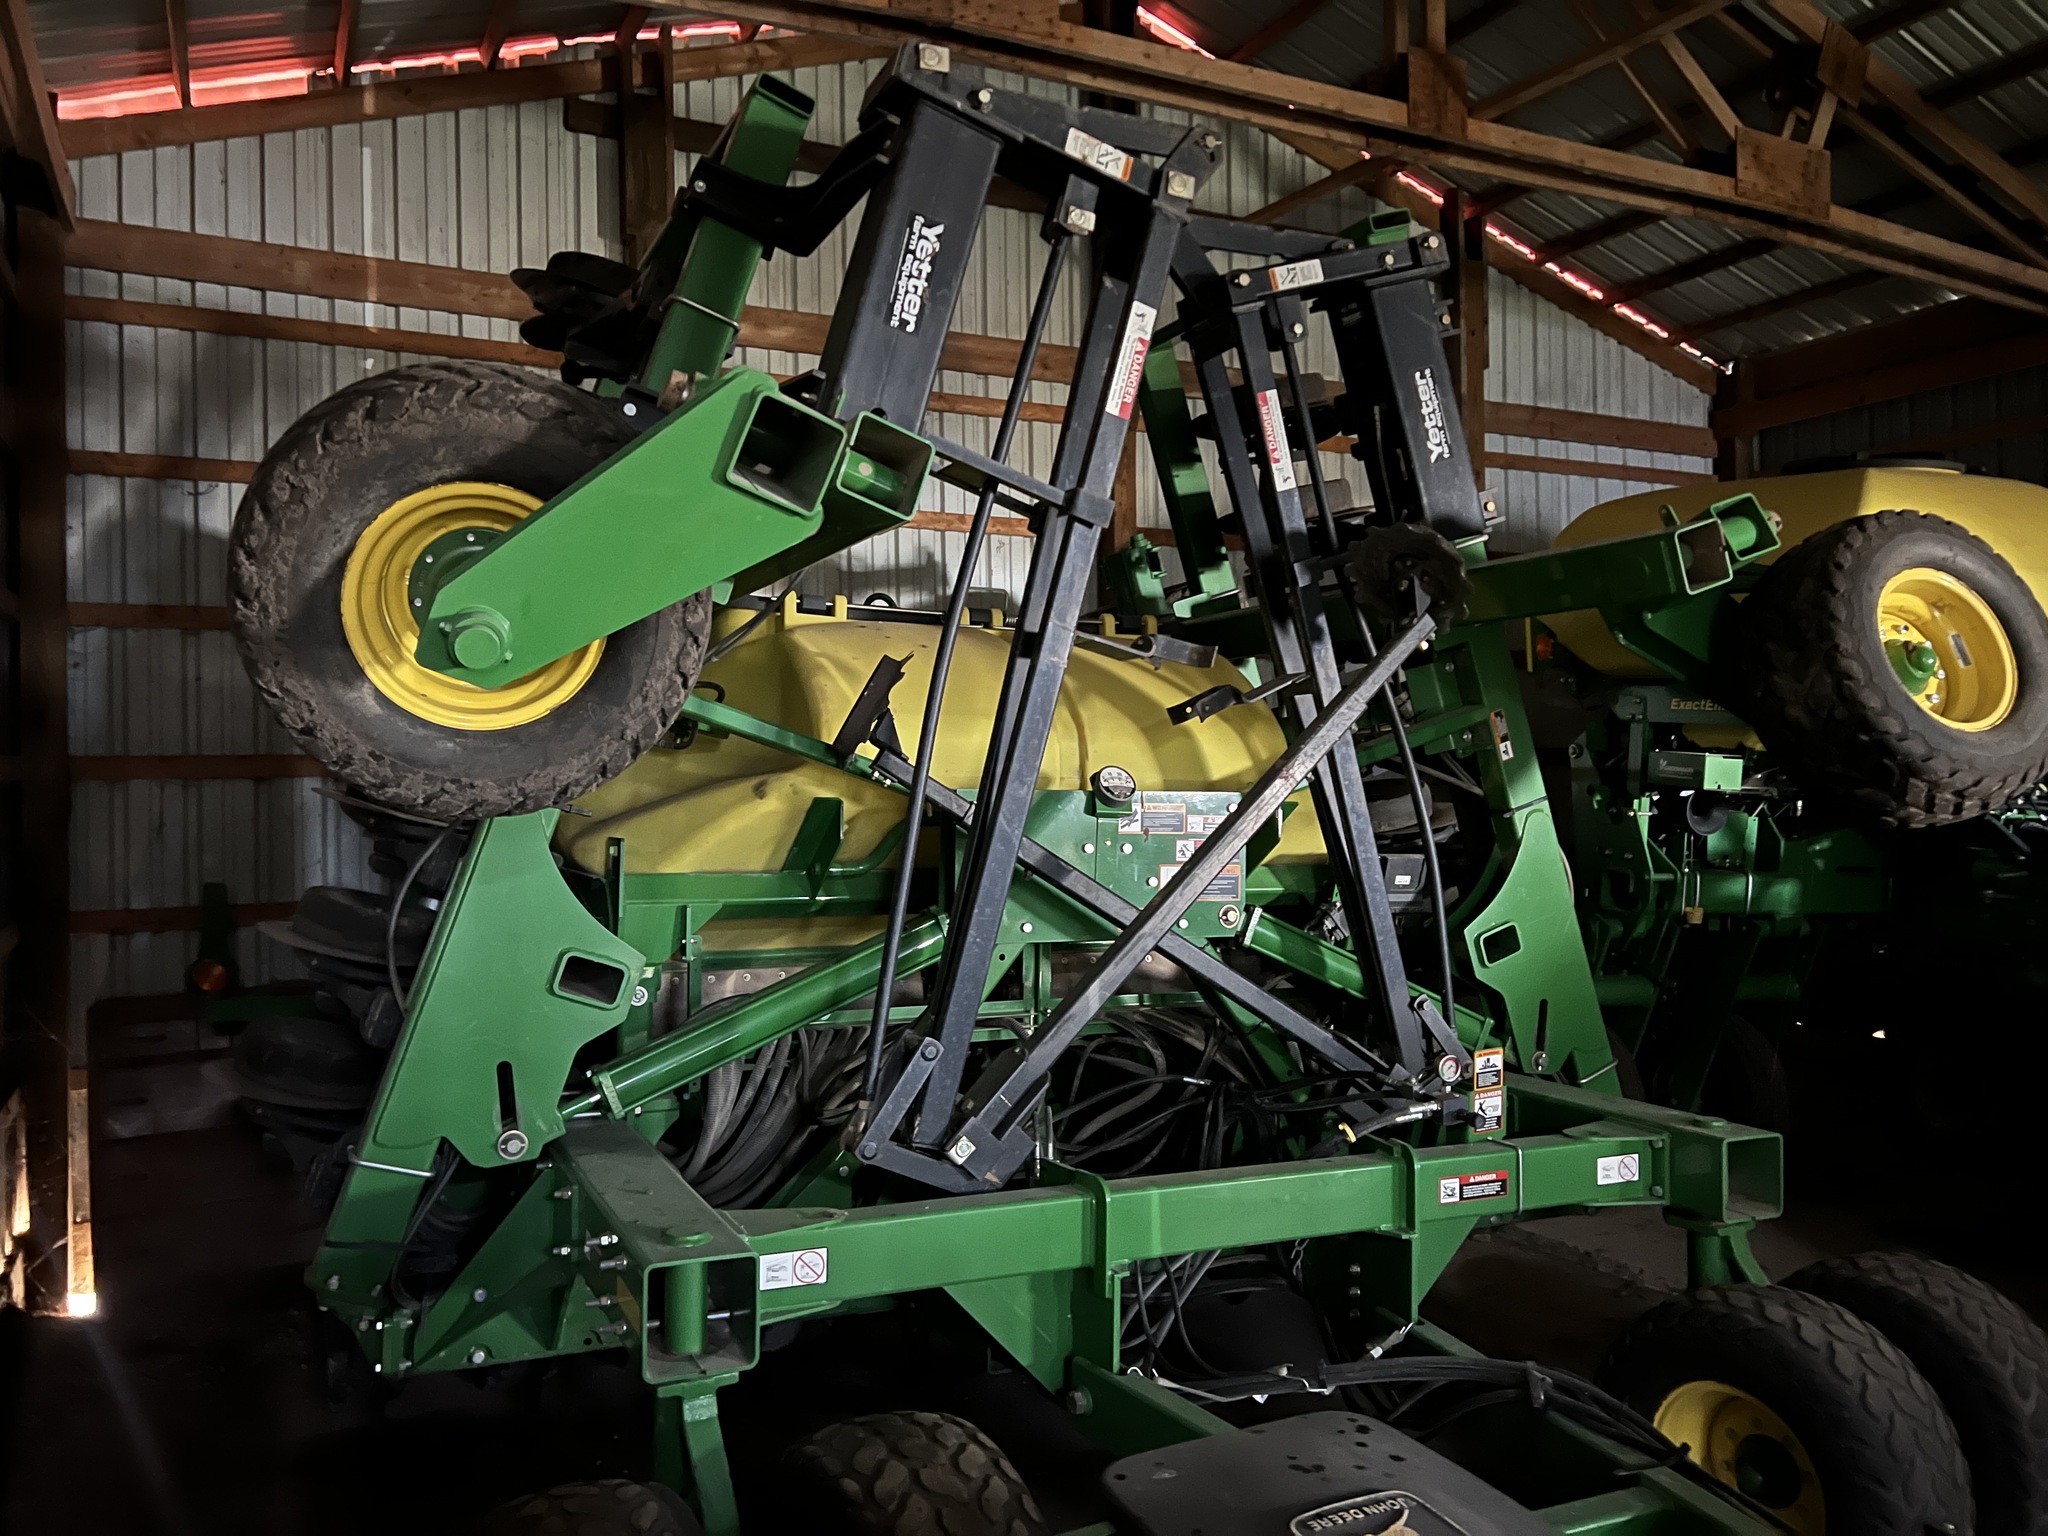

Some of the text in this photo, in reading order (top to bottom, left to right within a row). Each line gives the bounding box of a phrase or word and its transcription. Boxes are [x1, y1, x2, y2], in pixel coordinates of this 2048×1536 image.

[890, 215, 925, 328] farm equipment
[901, 223, 945, 333] Yetter
[1122, 354, 1144, 405] DANGER
[1414, 370, 1443, 464] Yetter
[1424, 367, 1451, 459] farm equipment
[1261, 405, 1277, 449] DANGER
[1306, 1497, 1408, 1532] JOHN DEERE
